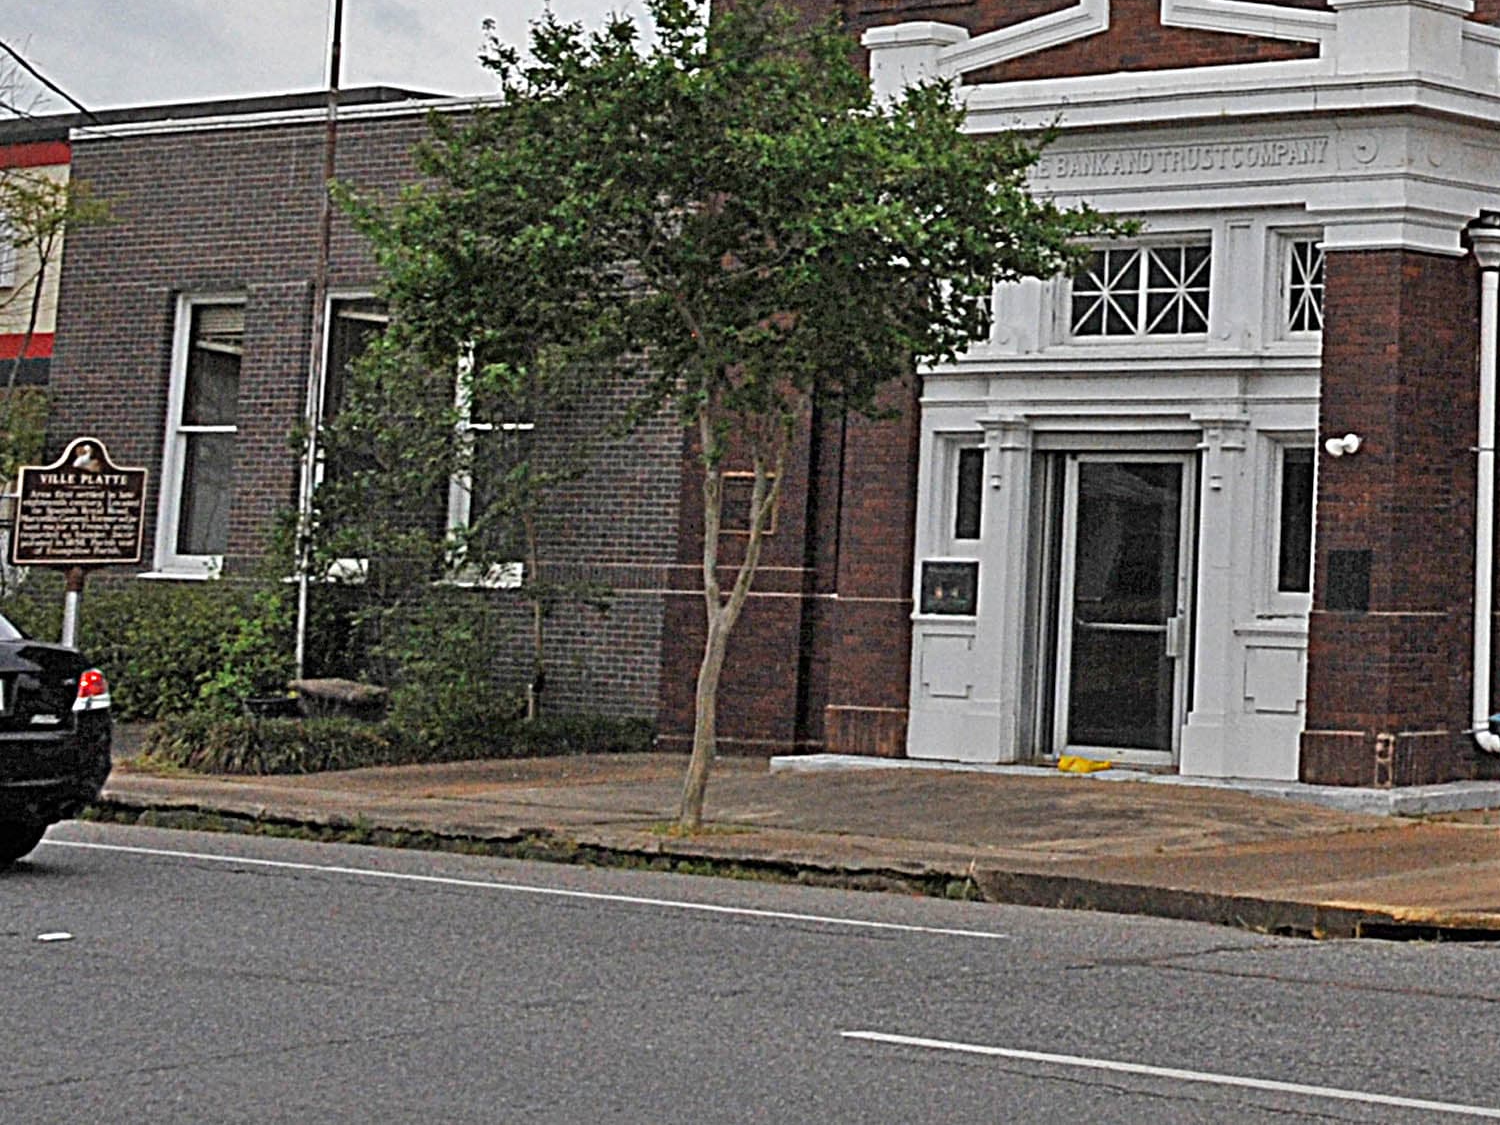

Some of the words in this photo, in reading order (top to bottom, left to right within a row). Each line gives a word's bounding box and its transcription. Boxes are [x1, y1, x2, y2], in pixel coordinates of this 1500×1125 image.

[1056, 153, 1111, 179] BANK
[1111, 149, 1153, 176] AND
[1157, 146, 1231, 174] TRUST
[1231, 138, 1329, 170] COMPANY
[40, 473, 76, 485] VILLE
[80, 473, 129, 486] PLATTE
